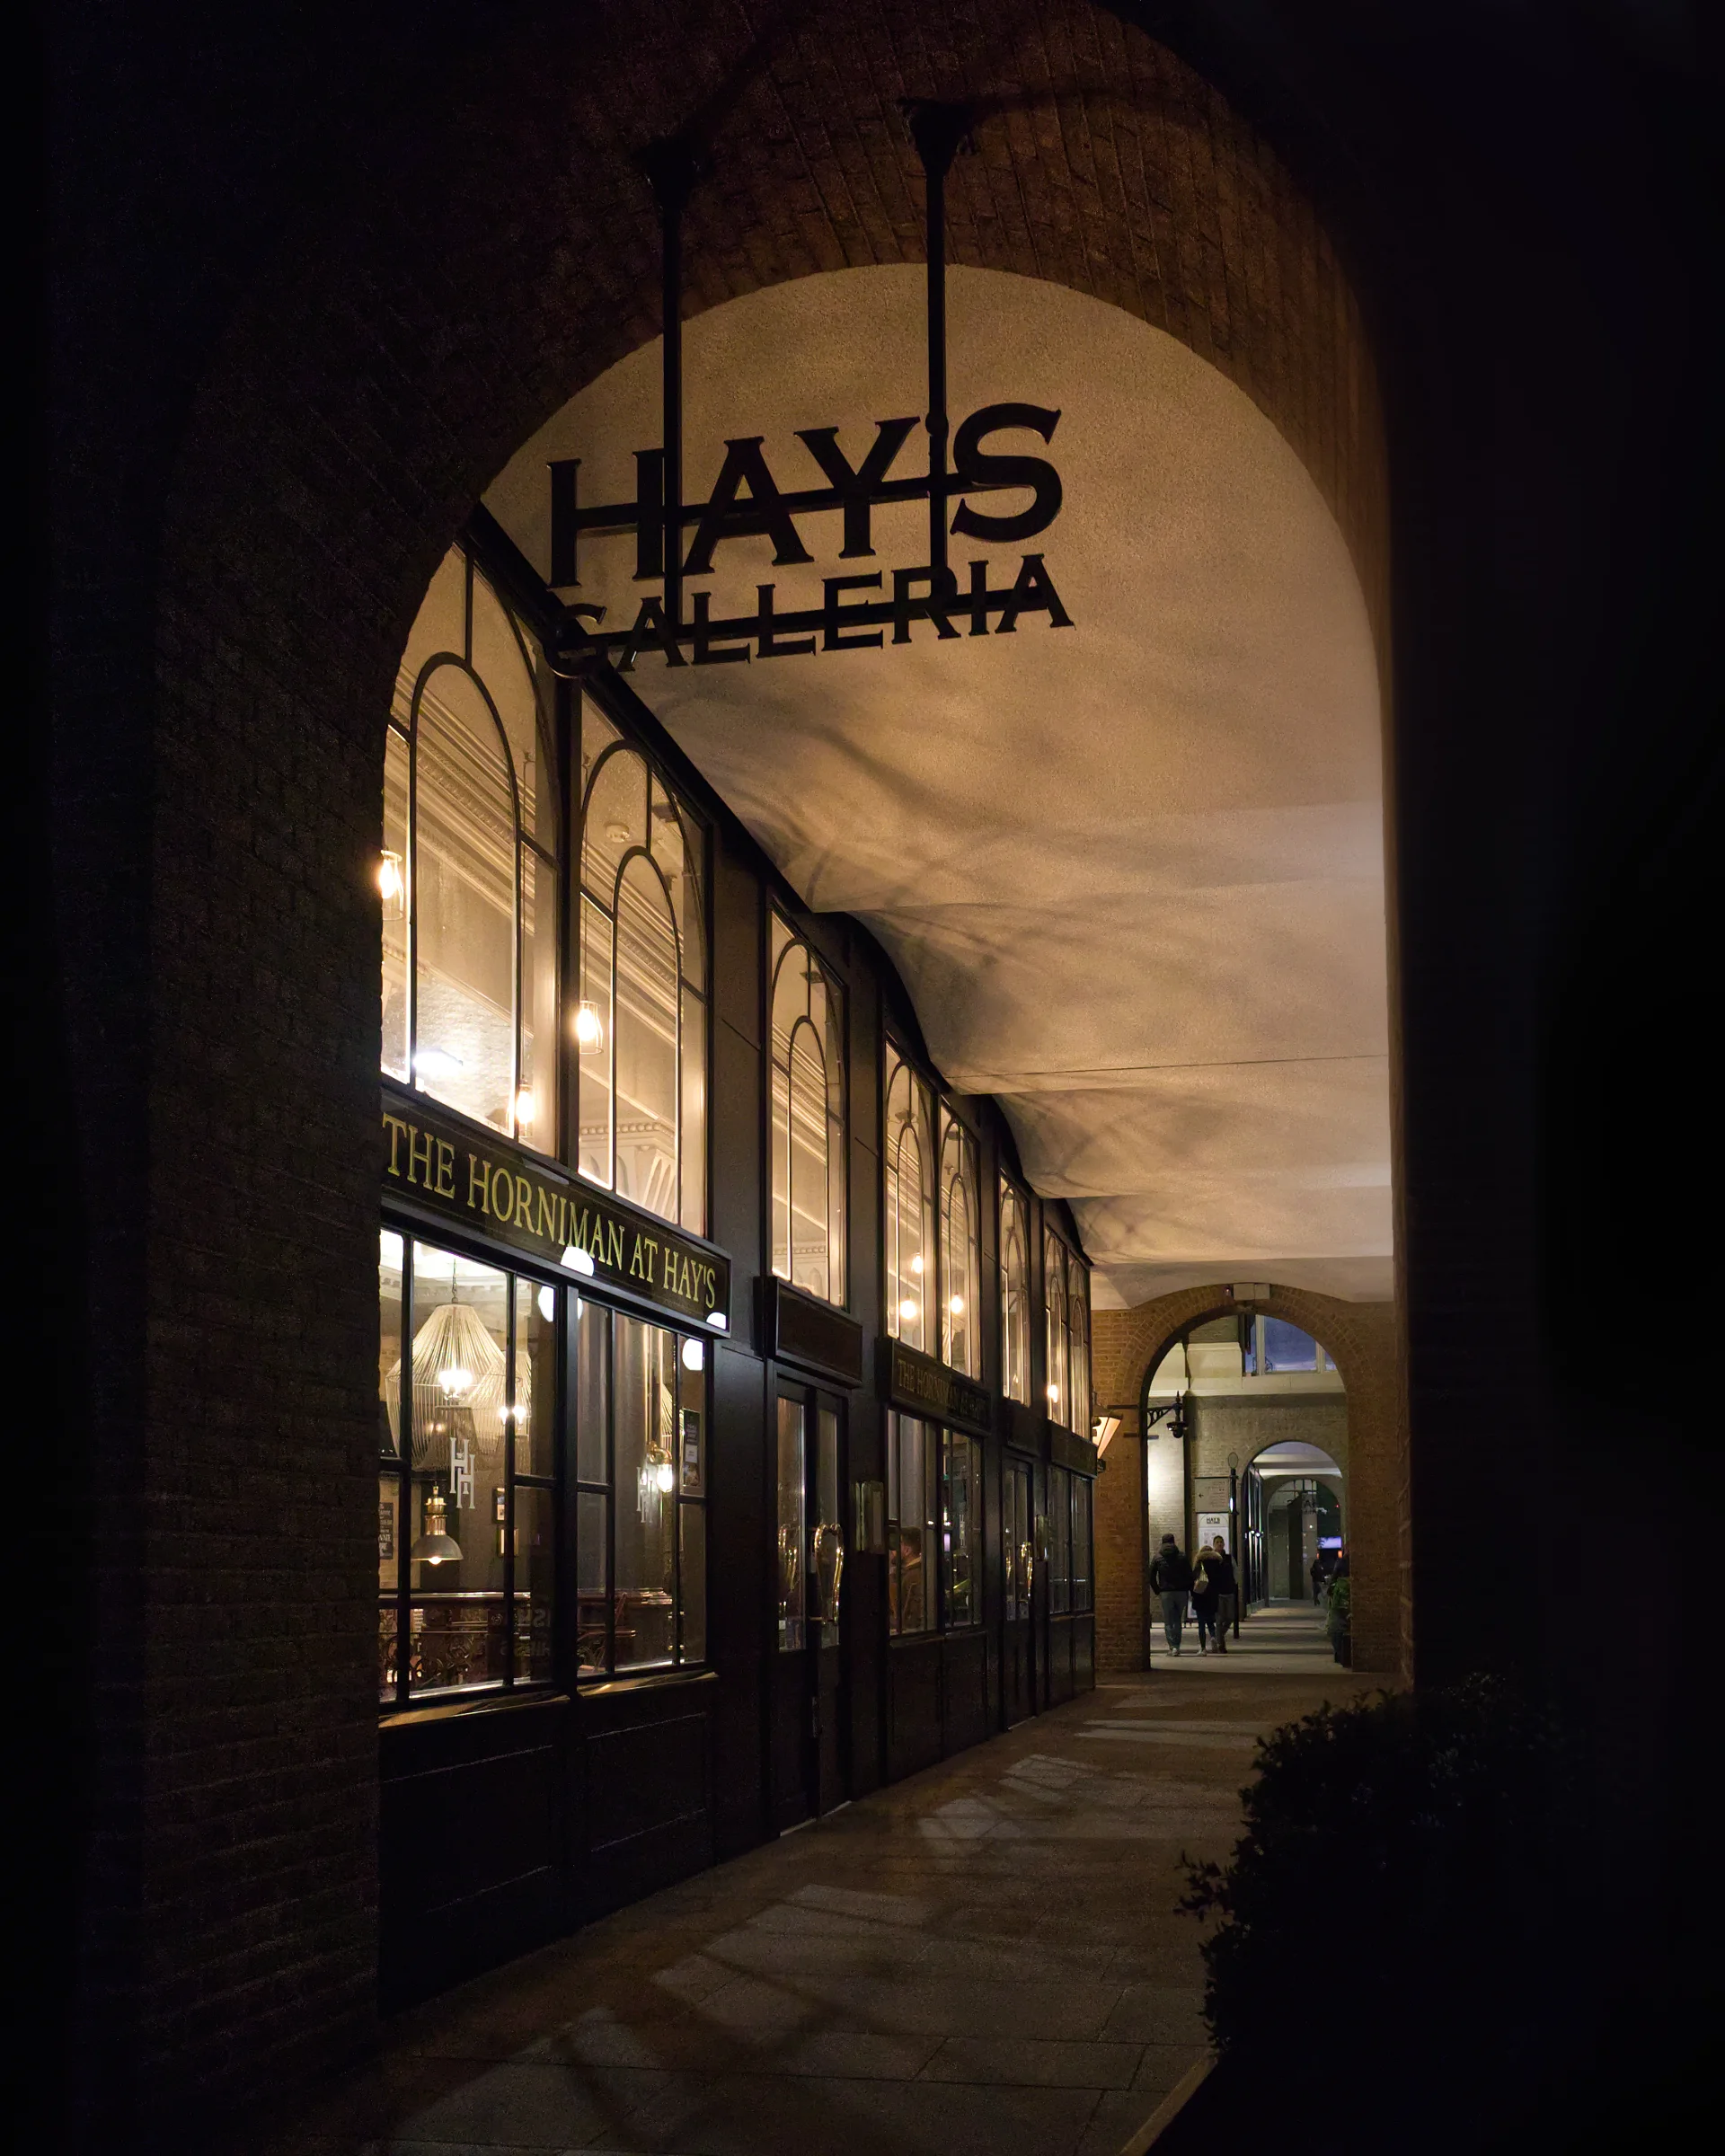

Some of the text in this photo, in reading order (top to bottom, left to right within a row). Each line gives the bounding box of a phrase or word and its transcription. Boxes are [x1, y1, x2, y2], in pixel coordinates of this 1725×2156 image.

[543, 553, 1075, 679] GALLERIA
[383, 1112, 717, 1310] THE HORNIMAN AT HAY'S
